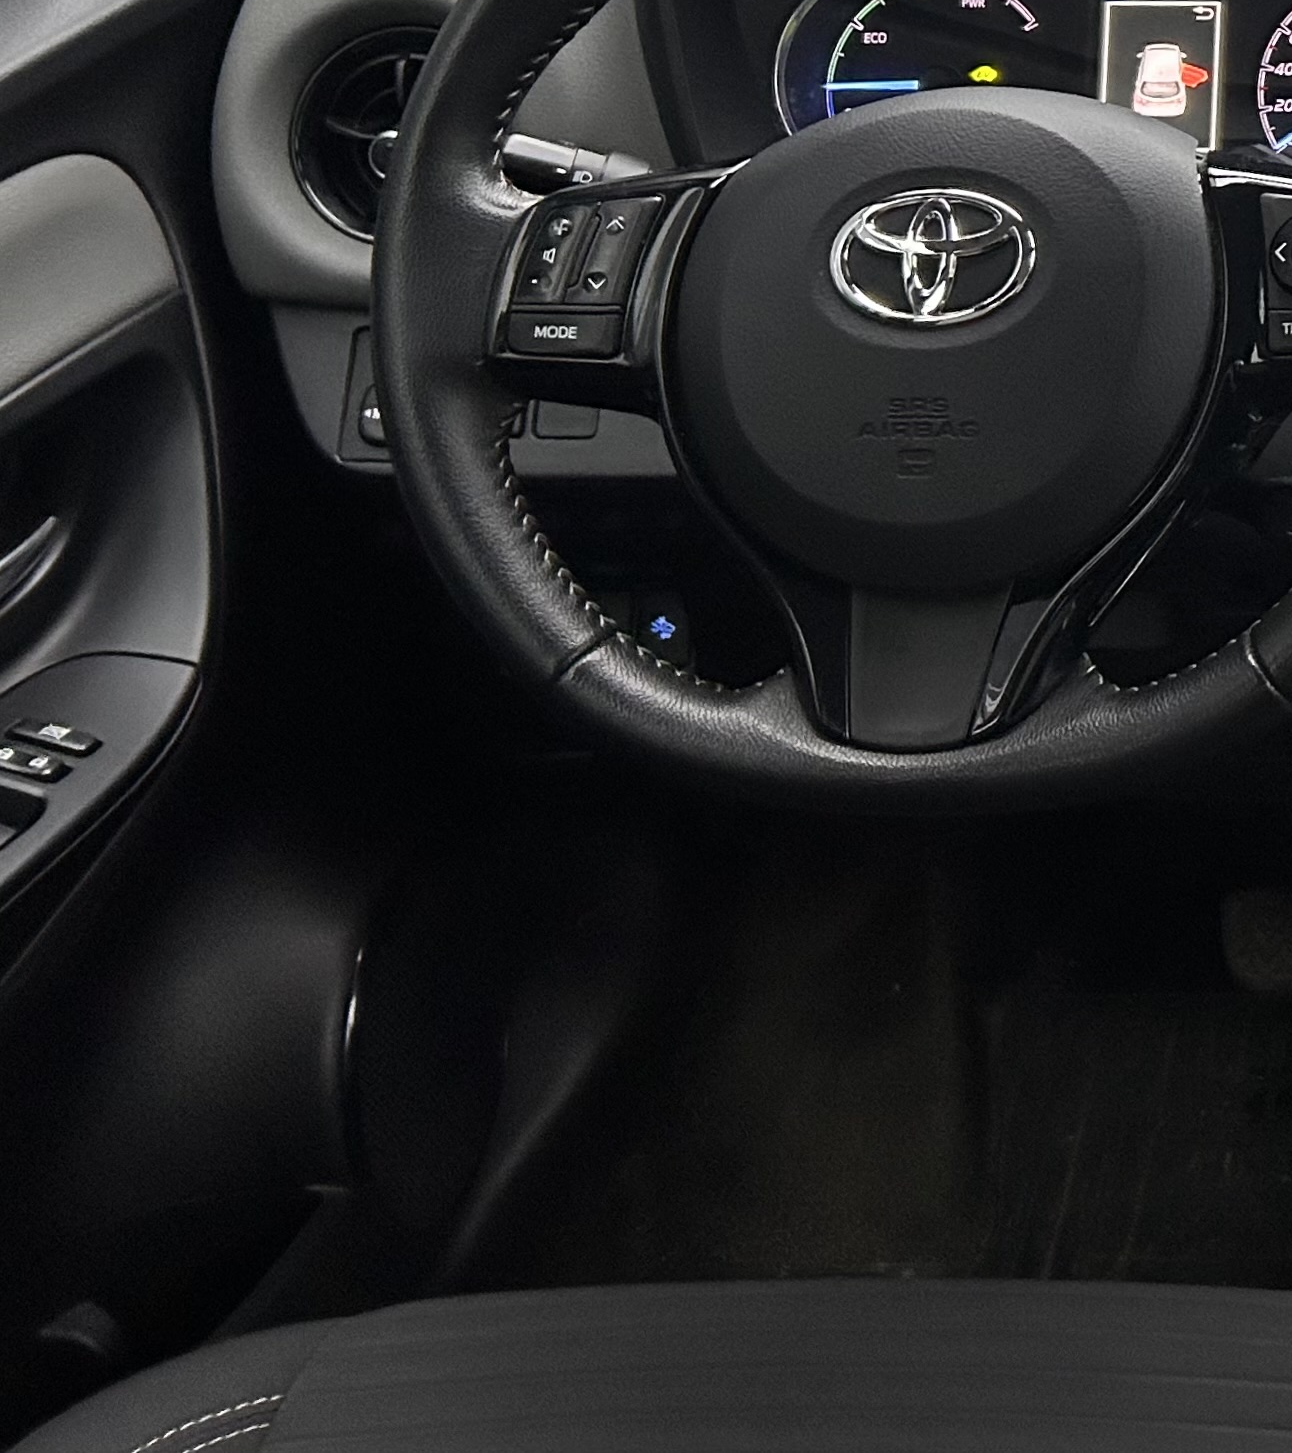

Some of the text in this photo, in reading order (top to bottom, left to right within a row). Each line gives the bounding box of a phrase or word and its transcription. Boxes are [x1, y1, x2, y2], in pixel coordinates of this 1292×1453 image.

[863, 32, 887, 44] ECO
[534, 325, 578, 340] MODE
[860, 420, 979, 440] AIRBAG
